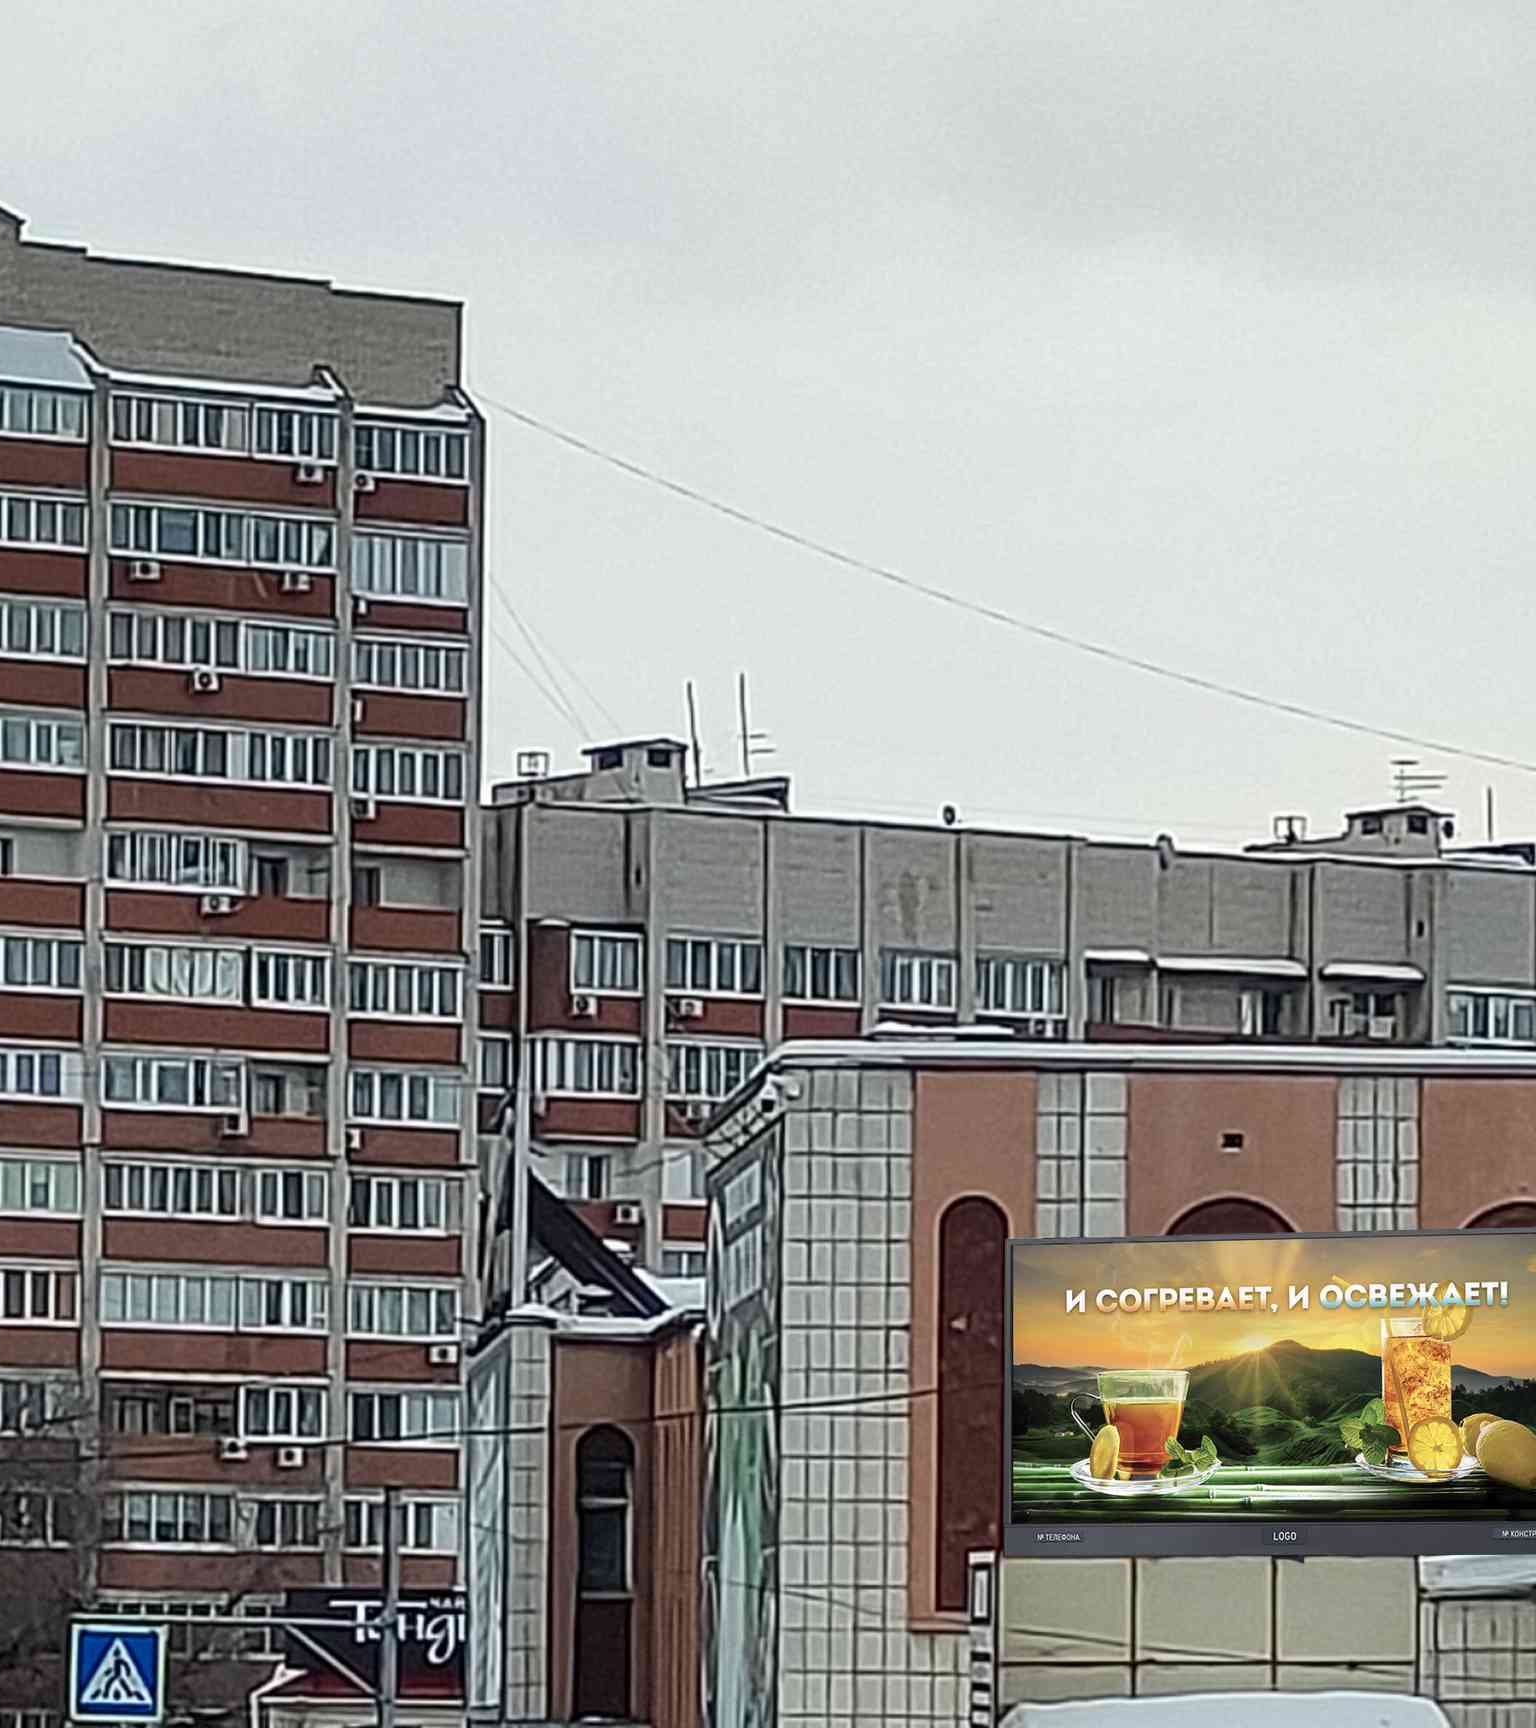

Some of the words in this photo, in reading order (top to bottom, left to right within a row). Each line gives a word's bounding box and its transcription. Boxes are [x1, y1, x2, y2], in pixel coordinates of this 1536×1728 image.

[1065, 1289, 1086, 1313] И
[1095, 1286, 1279, 1313] СОГРЕВАЕТ,
[1287, 1284, 1310, 1310] И
[1319, 1281, 1510, 1308] ОСВЕЖАЕТ!
[1273, 1531, 1297, 1541] LOGO
